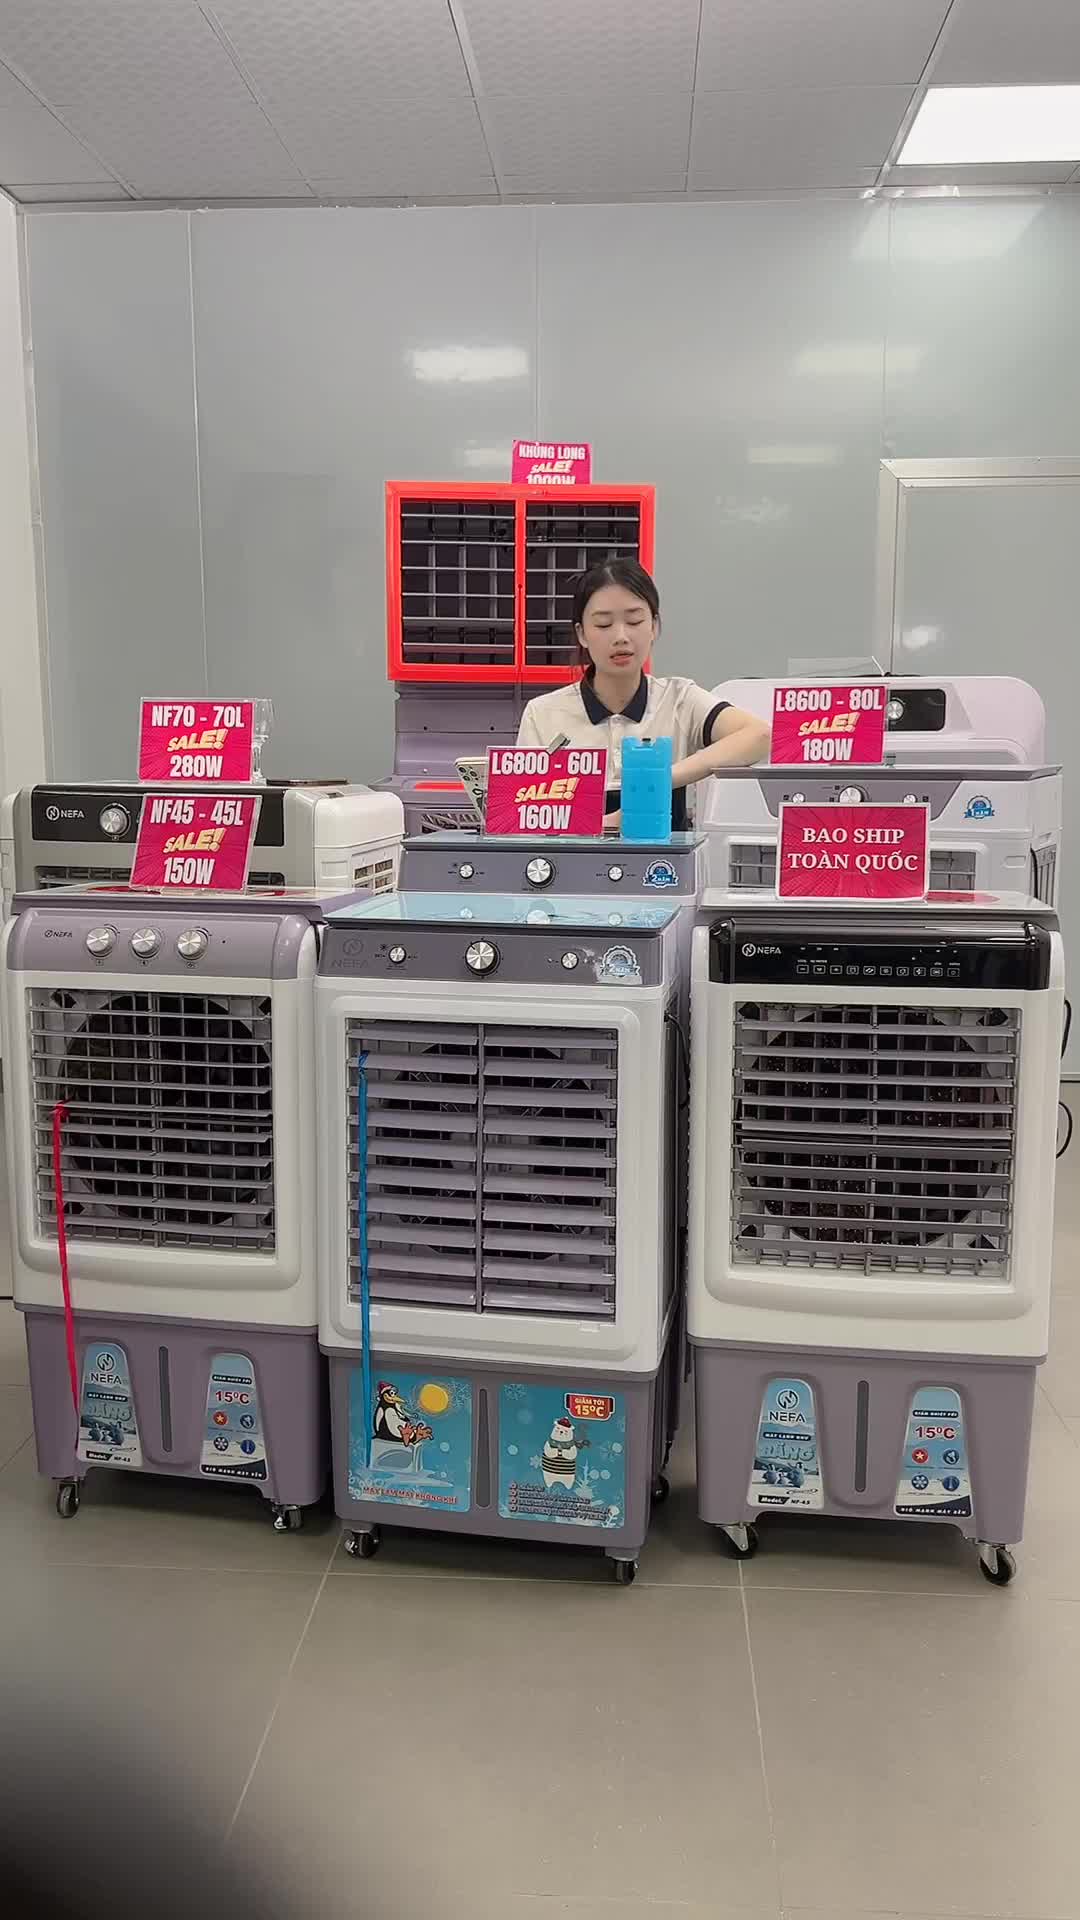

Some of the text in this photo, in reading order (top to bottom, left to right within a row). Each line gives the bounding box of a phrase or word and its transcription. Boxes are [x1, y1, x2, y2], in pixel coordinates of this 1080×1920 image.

[519, 442, 586, 460] KHỦNG LONG
[775, 689, 832, 712] L8600
[849, 688, 883, 711] 80L
[151, 705, 196, 727] NF70
[213, 705, 245, 728] 70L
[797, 712, 861, 737] SALE!
[167, 728, 229, 752] SALE!
[801, 738, 854, 762] 180W
[169, 754, 223, 778] 280W
[491, 751, 550, 775] L6800
[567, 751, 602, 775] 60L
[514, 776, 580, 803] SALE!
[60, 809, 85, 818] NEFA
[150, 799, 196, 825] NF45
[210, 799, 244, 826] 45L
[517, 804, 572, 830] 160W
[163, 827, 227, 854] SALE!
[801, 827, 905, 844] BAO SHIP
[163, 857, 216, 885] 150W
[787, 850, 918, 874] TOÀN QUỐC
[757, 946, 782, 954] NEFA
[90, 1373, 122, 1385] NEFA
[769, 1411, 806, 1423] NEFA
